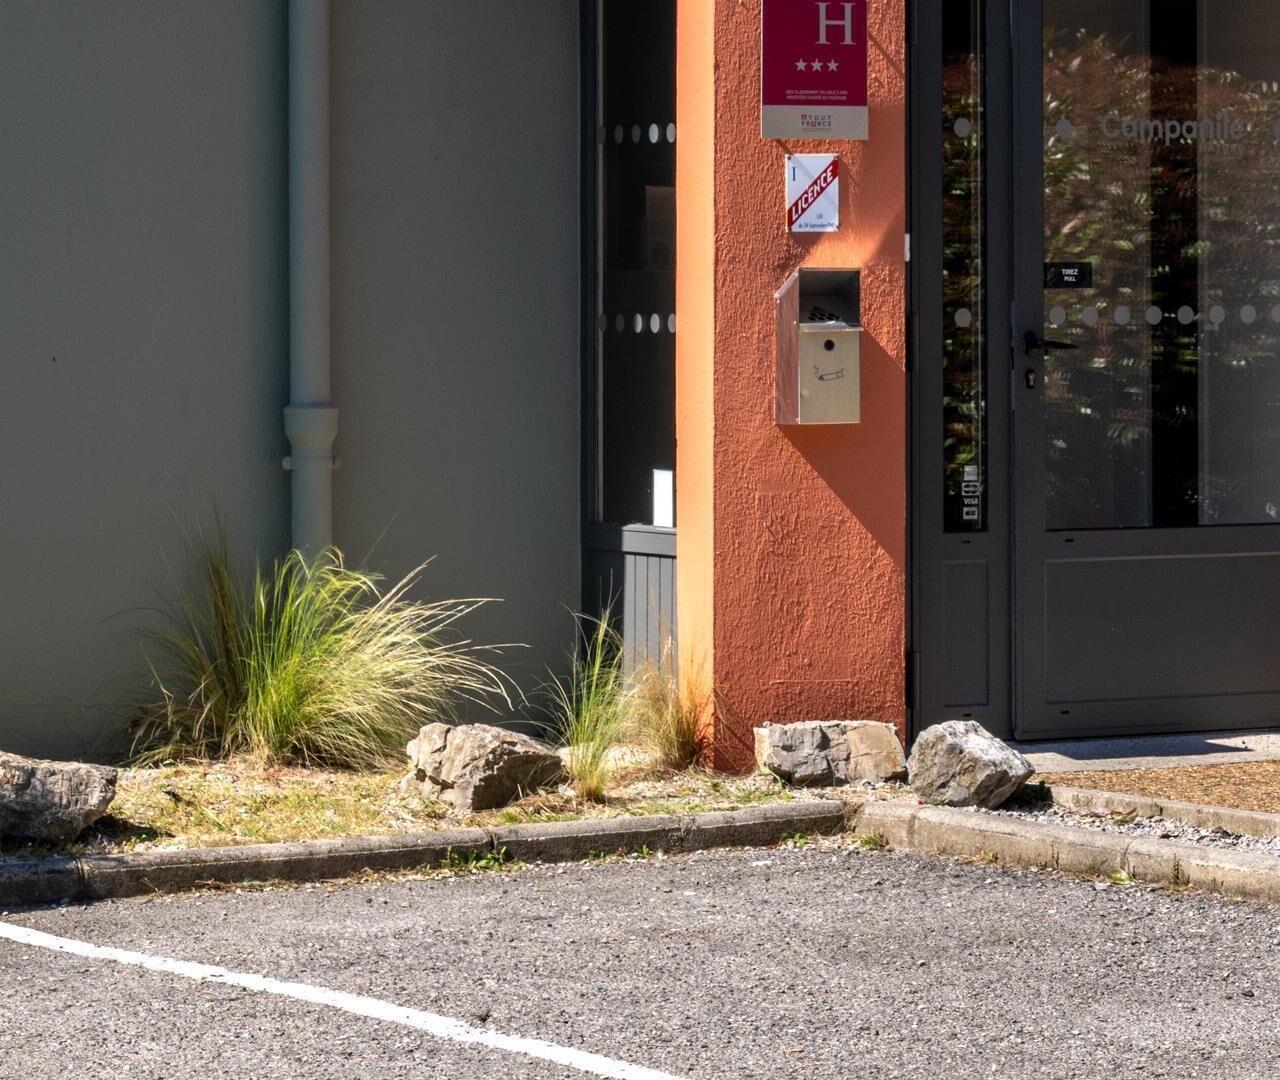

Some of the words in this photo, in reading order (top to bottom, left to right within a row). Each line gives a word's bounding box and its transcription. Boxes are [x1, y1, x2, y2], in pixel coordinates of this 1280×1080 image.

[814, 1, 857, 45] H
[1102, 112, 1245, 145] Campanile
[792, 165, 834, 222] LICENCE
